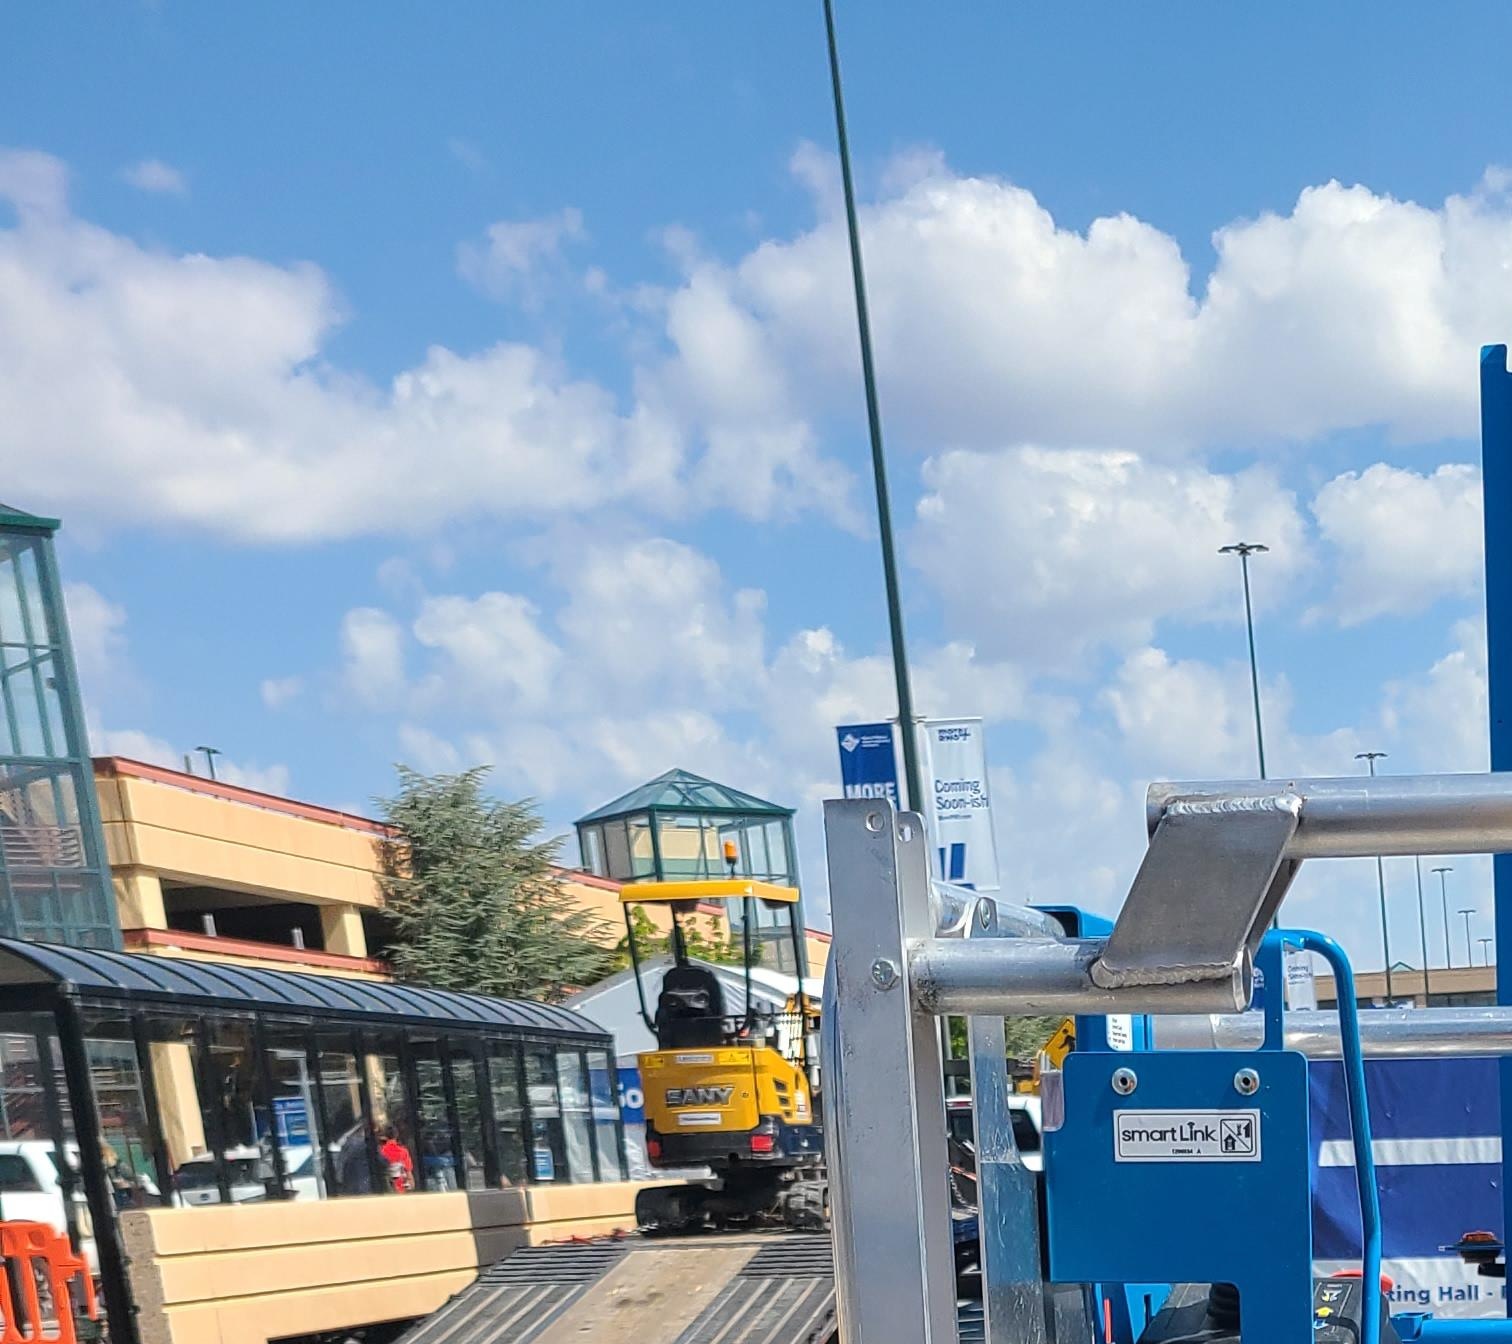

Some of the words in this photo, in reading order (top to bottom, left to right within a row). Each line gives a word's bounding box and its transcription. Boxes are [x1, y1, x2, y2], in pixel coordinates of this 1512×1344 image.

[935, 778, 981, 794] Coming
[936, 794, 990, 811] Soon-ish
[666, 1086, 735, 1107] SANY
[1437, 1284, 1480, 1302] Hall
